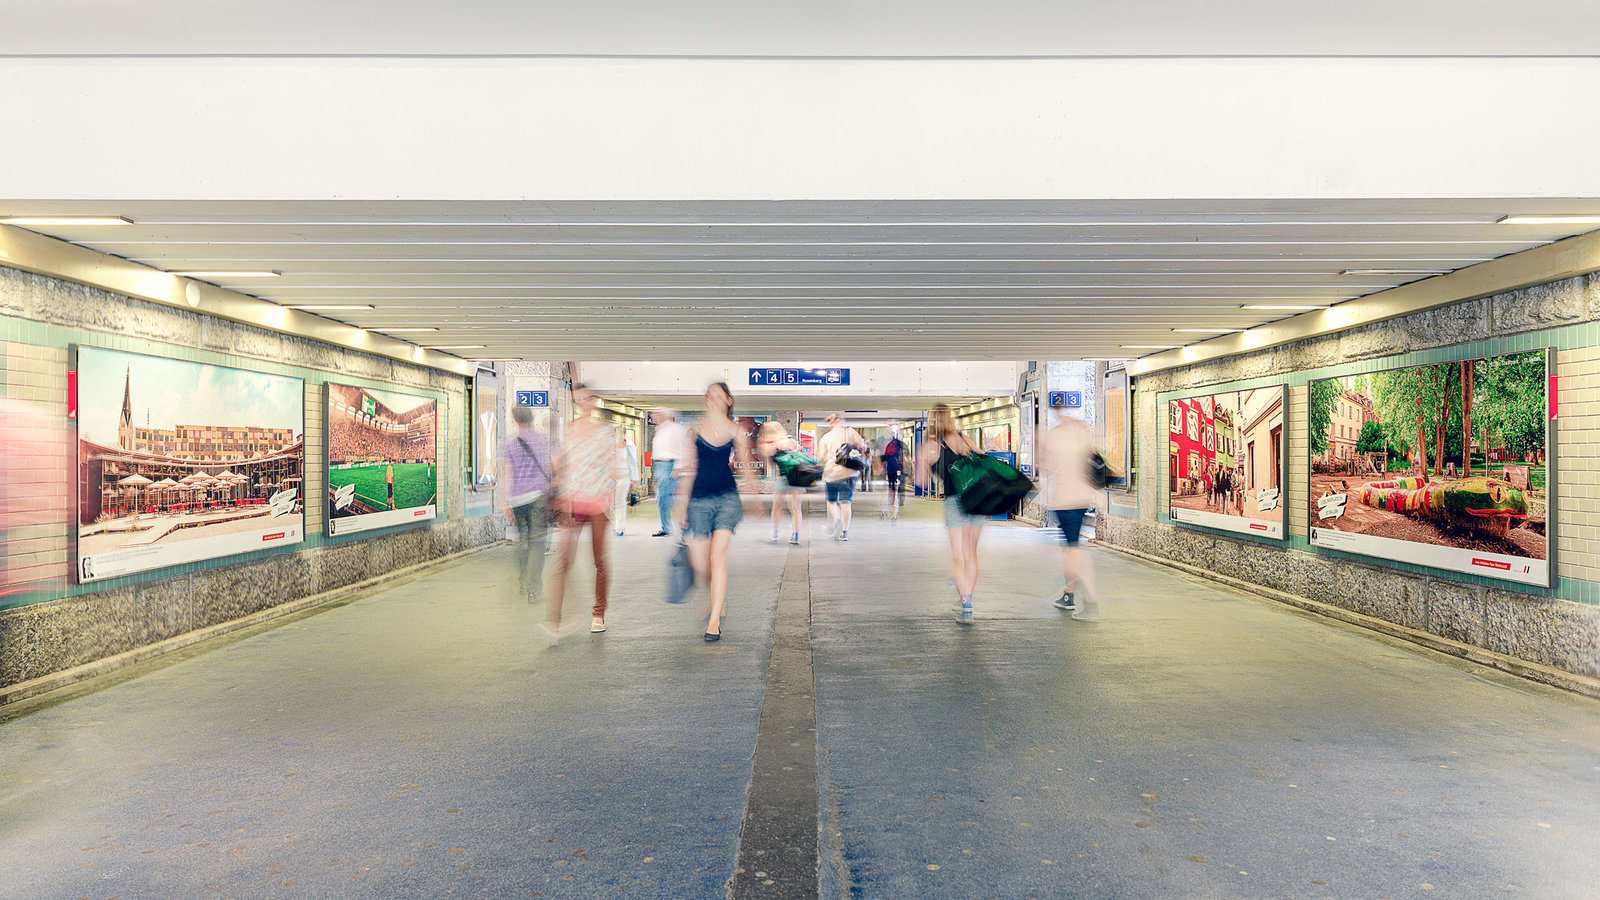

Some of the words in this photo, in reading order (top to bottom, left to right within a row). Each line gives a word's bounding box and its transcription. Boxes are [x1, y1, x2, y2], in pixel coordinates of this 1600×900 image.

[770, 374, 778, 382] 4
[787, 374, 794, 382] 5
[521, 396, 528, 404] 2
[536, 396, 543, 404] 3
[1055, 396, 1062, 404] 2
[1070, 396, 1077, 404] 3
